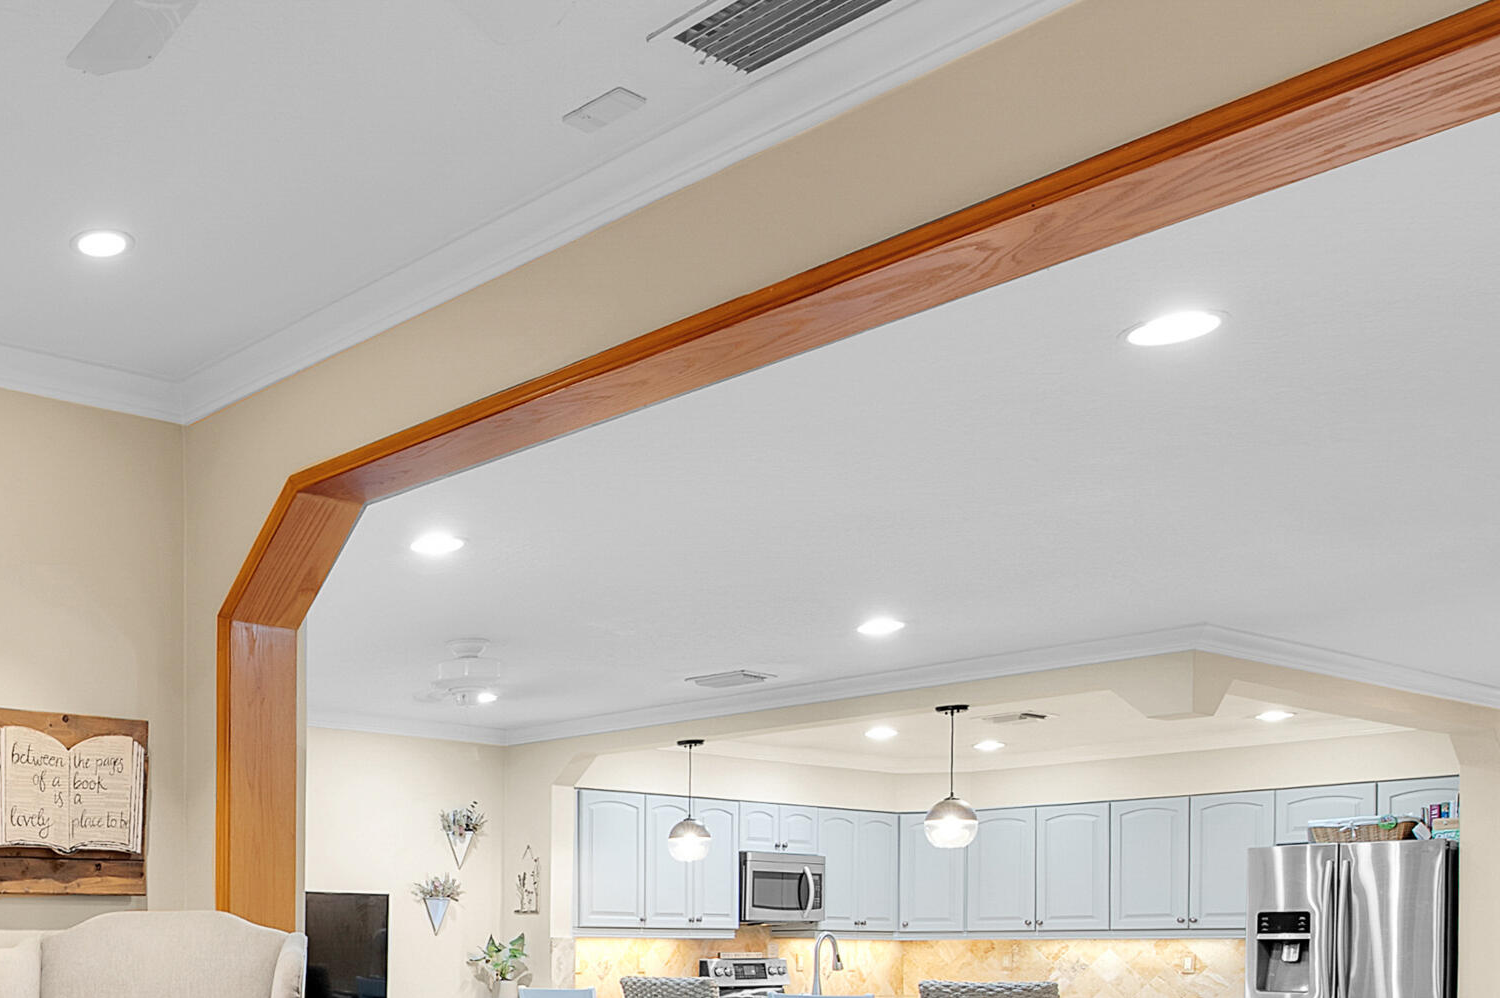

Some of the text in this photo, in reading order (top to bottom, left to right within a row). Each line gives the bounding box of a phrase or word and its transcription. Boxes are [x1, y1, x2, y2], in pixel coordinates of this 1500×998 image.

[11, 742, 124, 776] between the pages
[32, 771, 107, 793] of a book
[54, 792, 82, 808] is a
[10, 805, 54, 839] lovely
[71, 809, 103, 838] place
[106, 811, 117, 828] to
